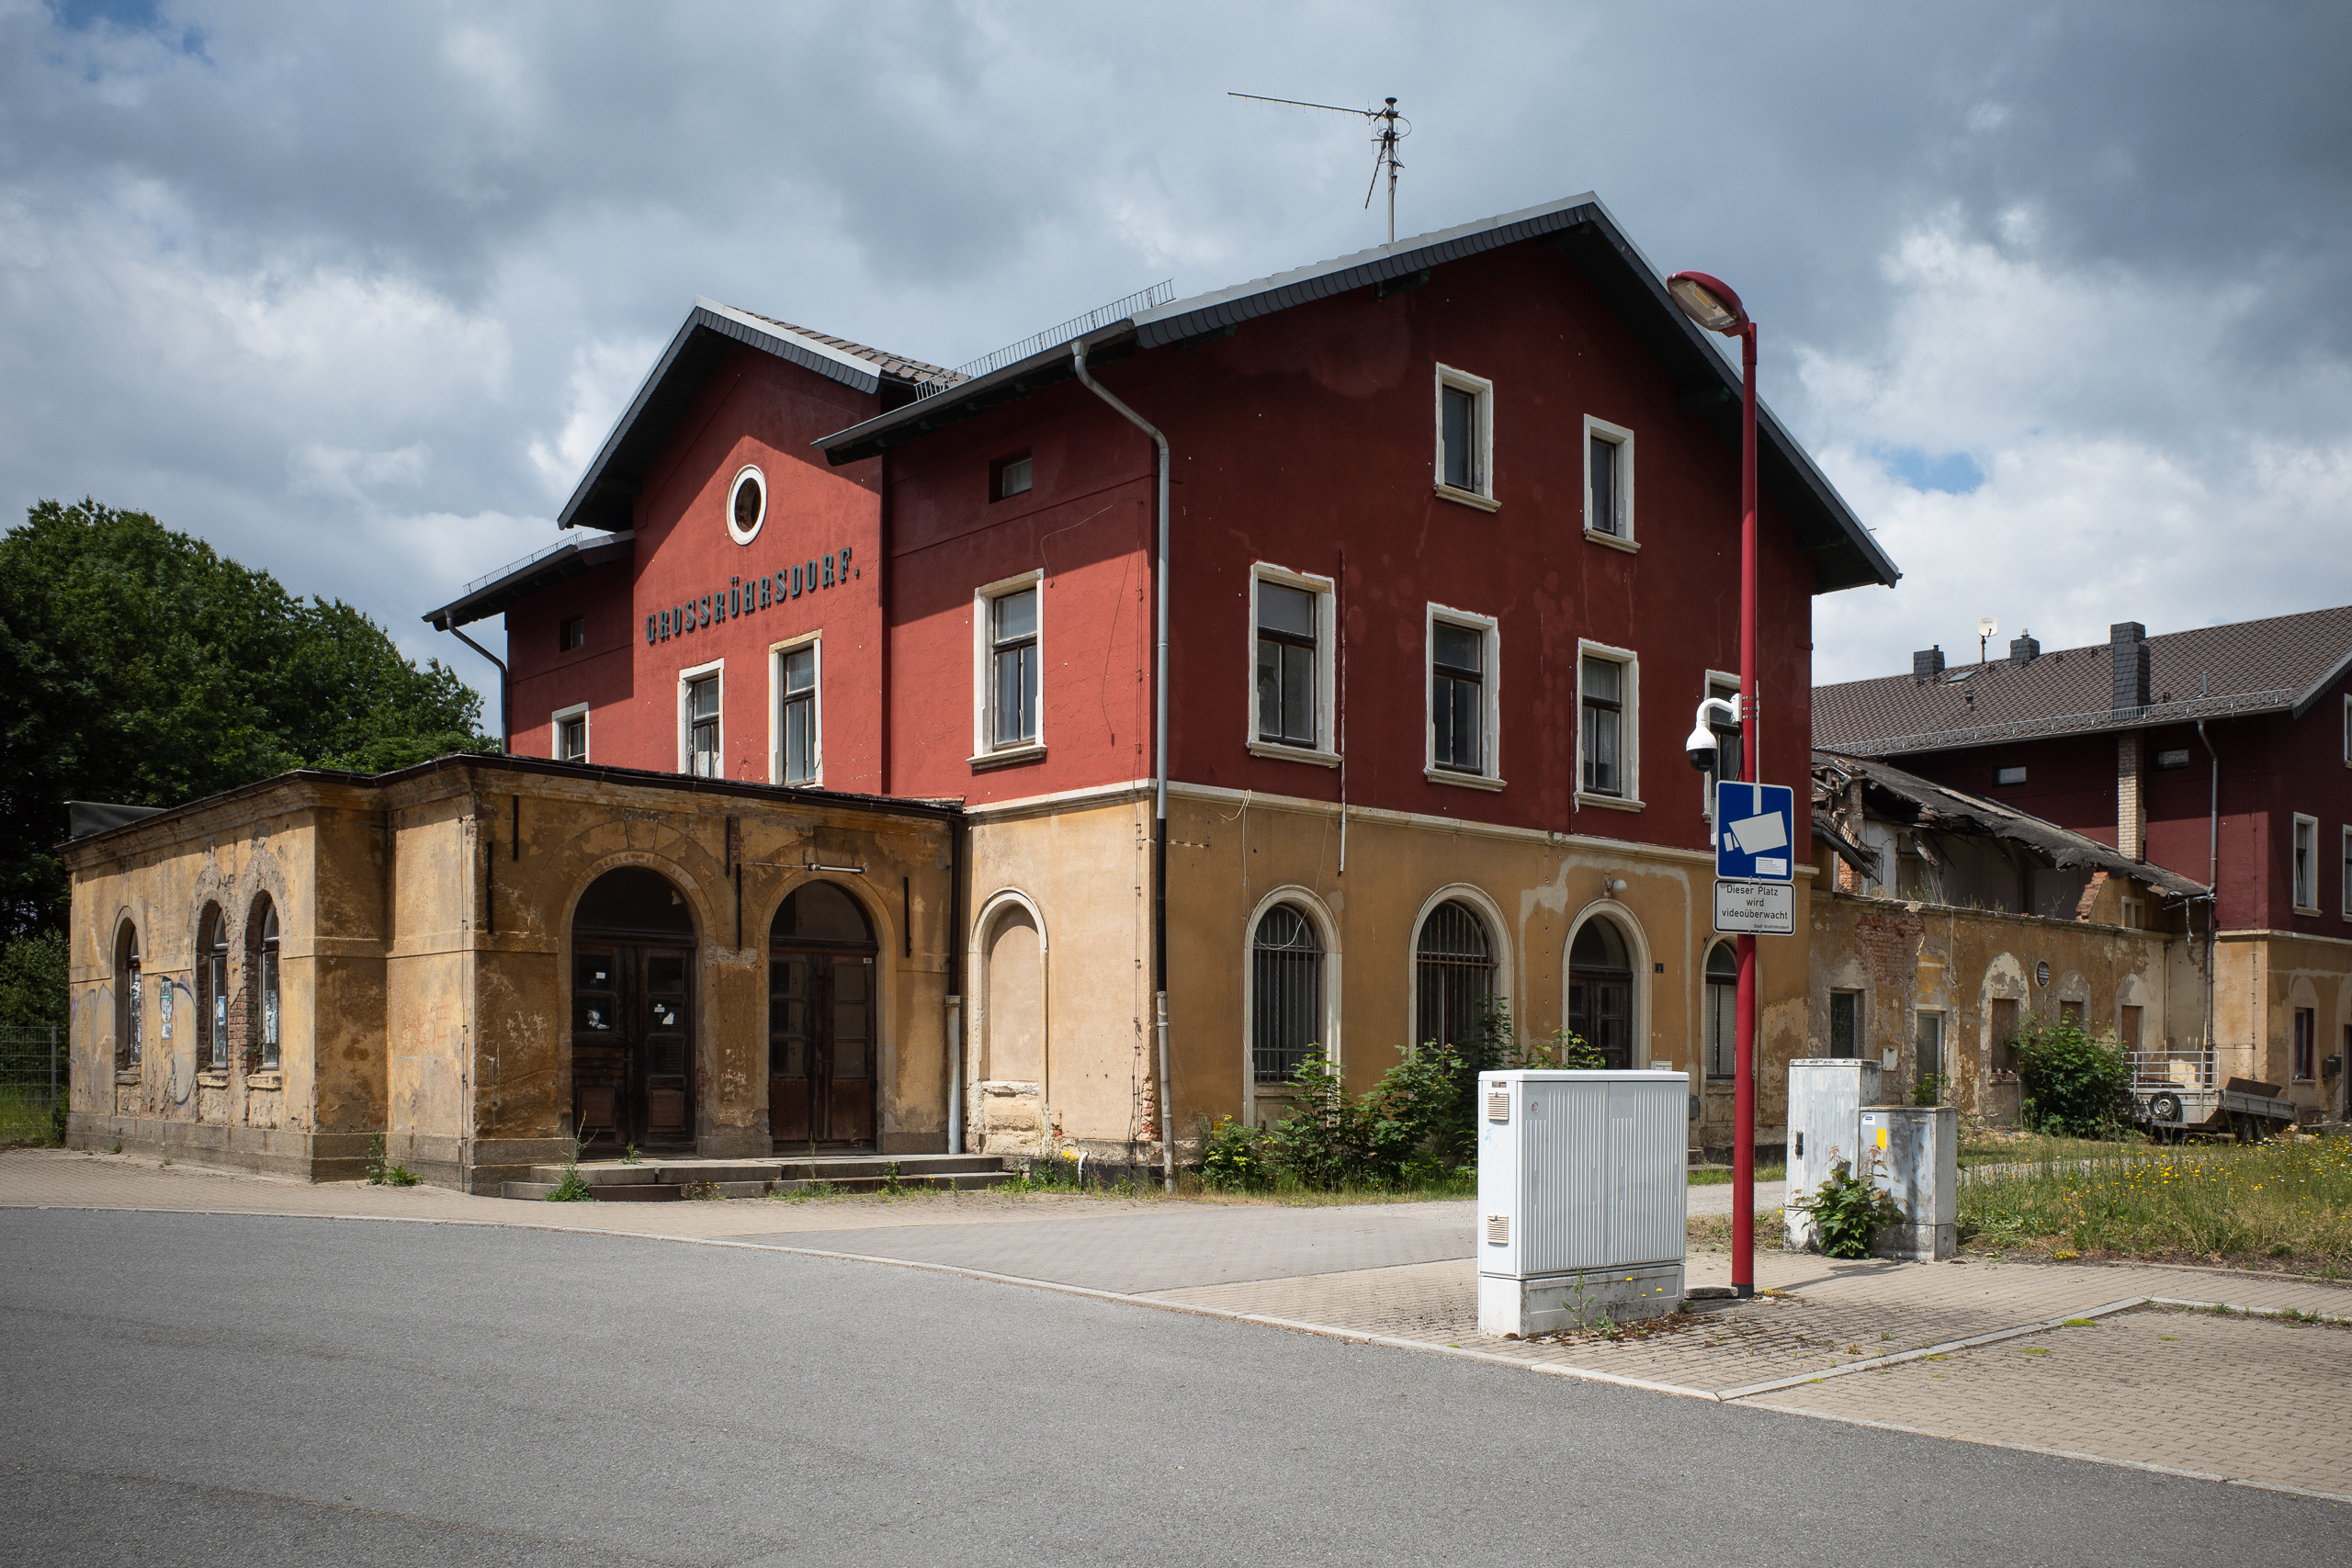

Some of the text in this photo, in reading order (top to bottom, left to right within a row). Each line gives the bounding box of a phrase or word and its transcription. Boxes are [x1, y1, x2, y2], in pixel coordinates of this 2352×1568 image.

[646, 547, 860, 644] GROSSRÖHRSDORF.
[1726, 885, 1778, 896] Dieser Platz
[1746, 897, 1764, 907] wird
[1722, 908, 1788, 919] videoüberwacht
